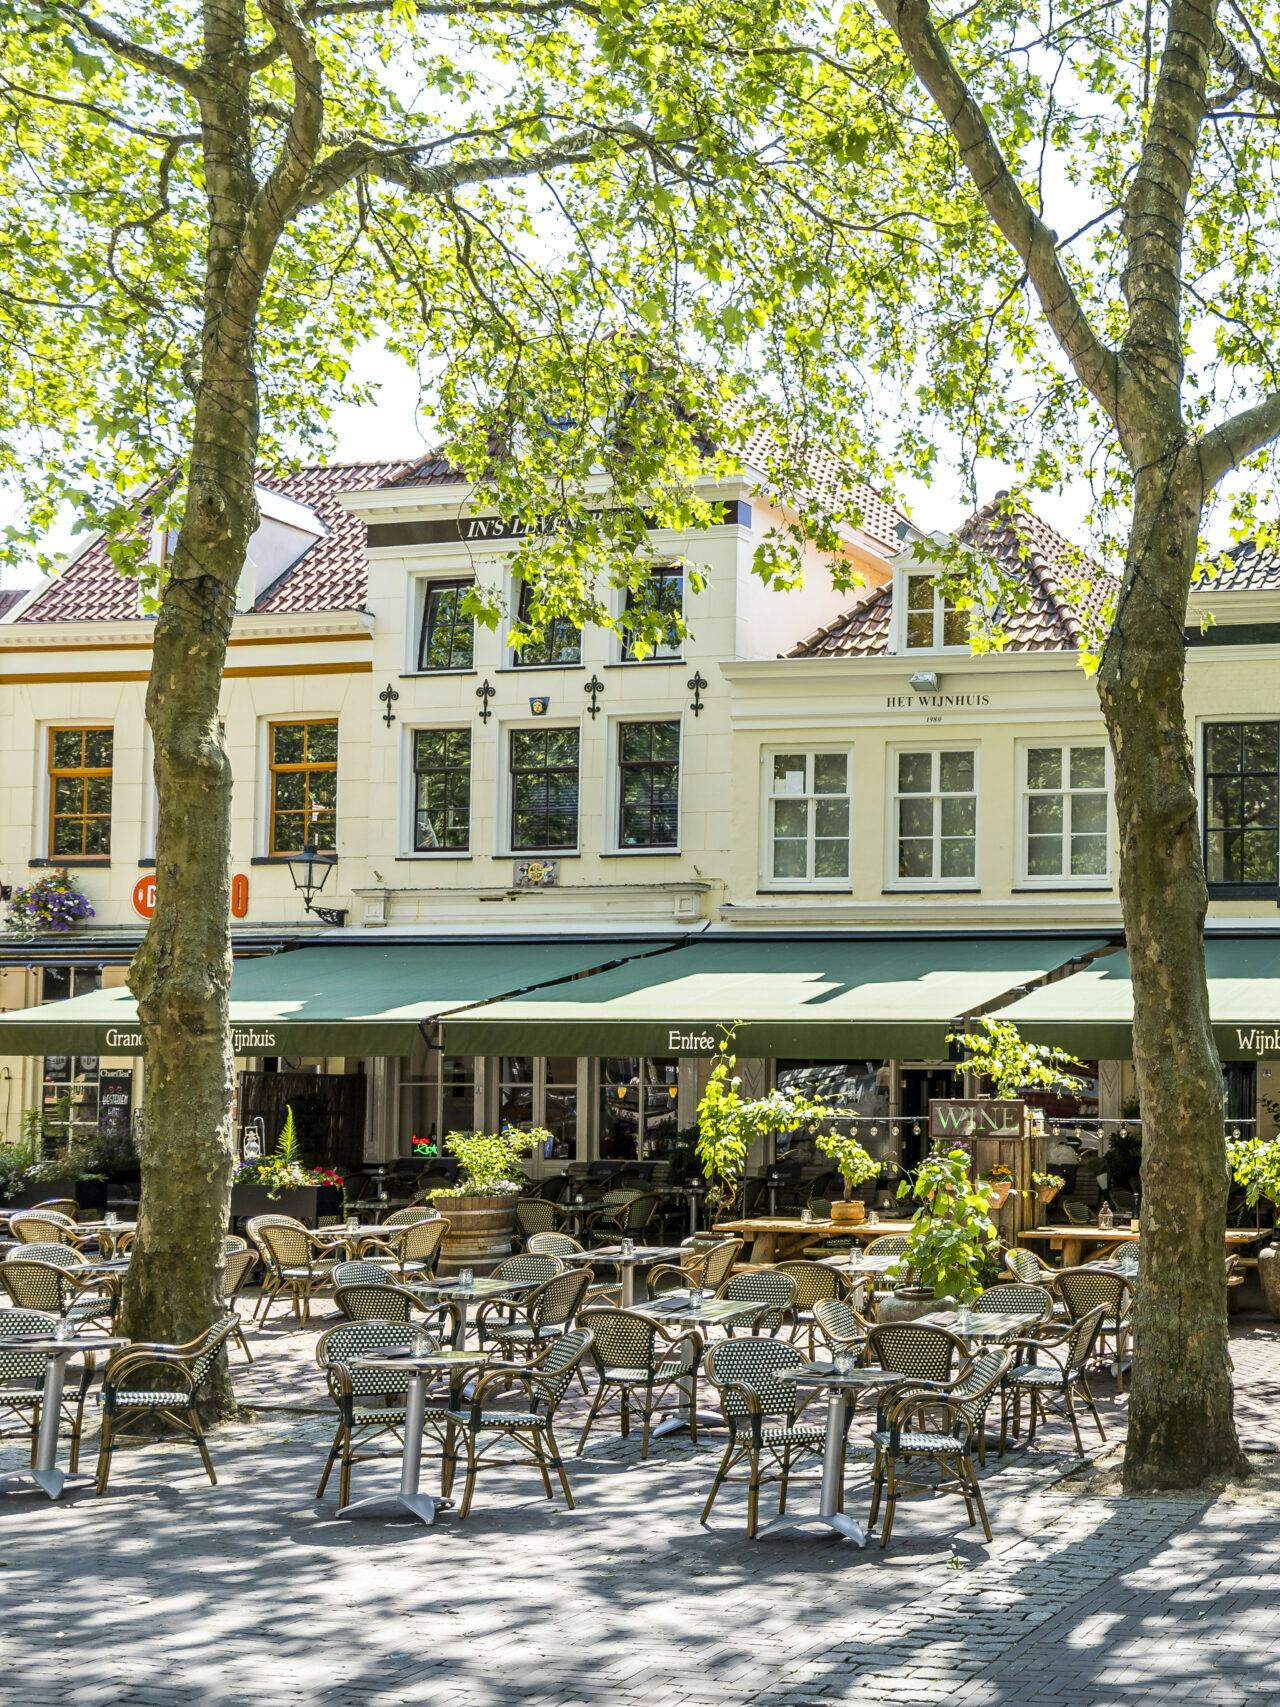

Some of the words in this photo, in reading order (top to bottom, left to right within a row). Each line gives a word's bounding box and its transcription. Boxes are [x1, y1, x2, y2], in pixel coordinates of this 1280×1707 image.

[466, 519, 504, 538] IN'S
[887, 696, 913, 707] HET
[918, 694, 990, 707] WIJNHUIS
[668, 1030, 715, 1050] Entrée
[935, 1106, 1020, 1131] WINE
